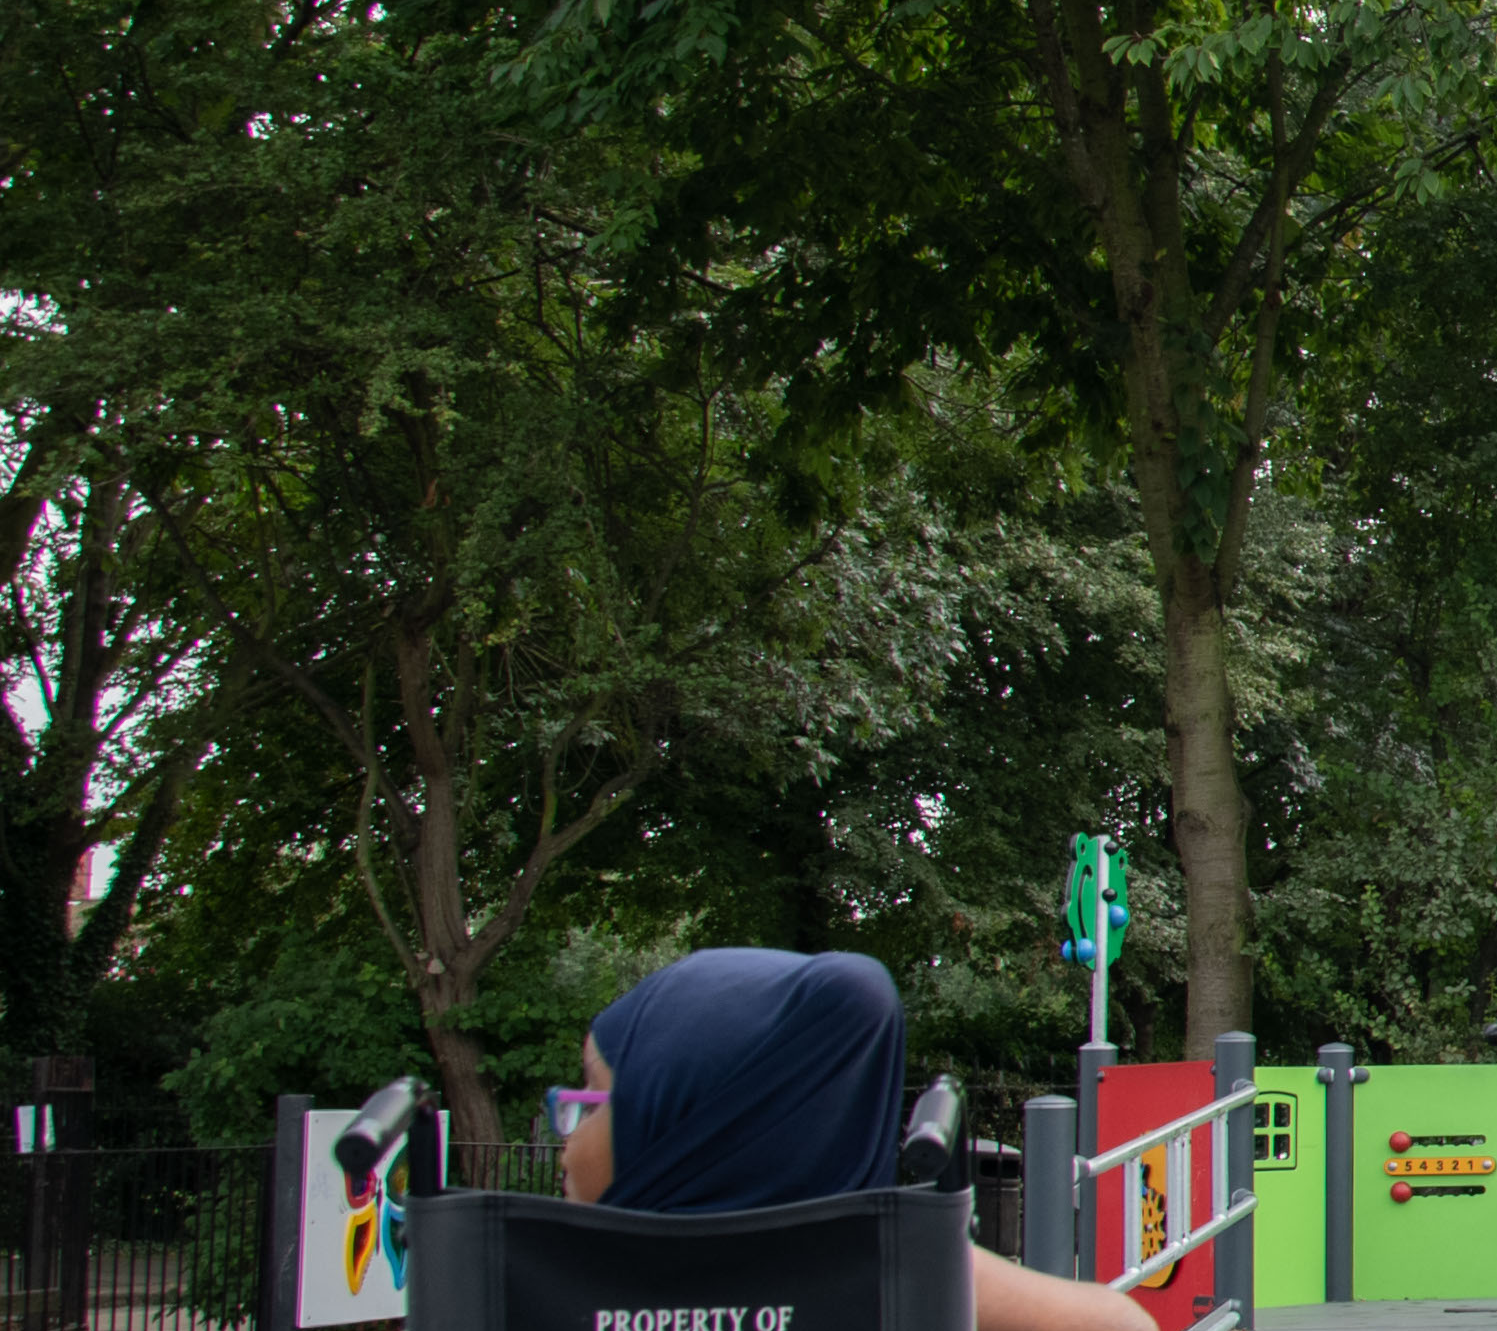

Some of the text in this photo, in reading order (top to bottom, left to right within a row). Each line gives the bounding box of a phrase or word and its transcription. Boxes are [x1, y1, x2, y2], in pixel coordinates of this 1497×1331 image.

[1405, 1159, 1474, 1171] 5 4 3 2 1
